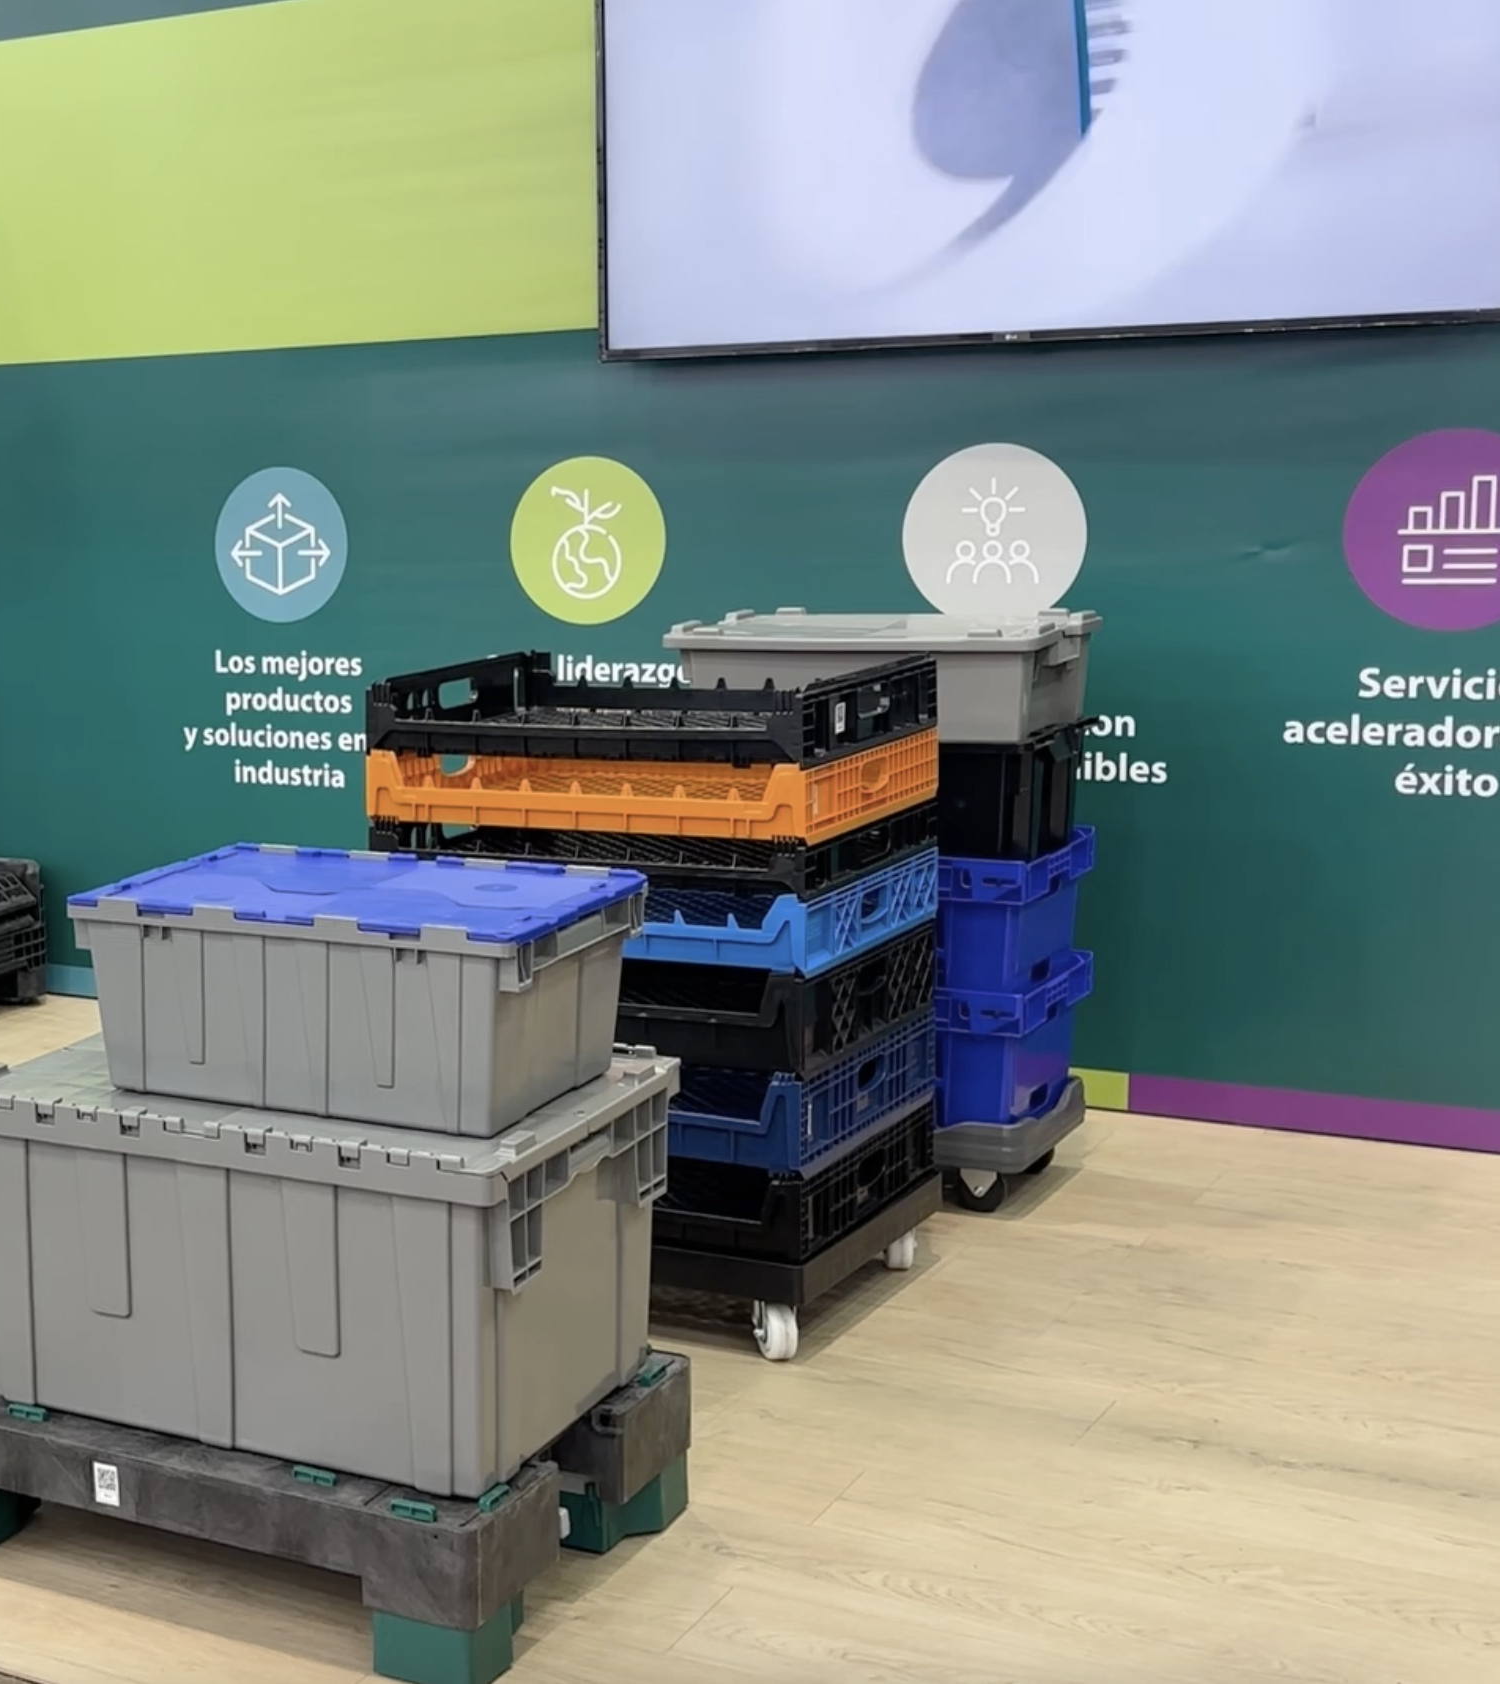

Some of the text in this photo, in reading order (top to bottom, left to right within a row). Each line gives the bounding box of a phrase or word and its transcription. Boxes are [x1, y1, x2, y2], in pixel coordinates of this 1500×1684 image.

[215, 649, 363, 682] Los mejores
[1358, 667, 1500, 701] Servici
[225, 686, 353, 716] productos
[182, 722, 367, 752] y soluciones en
[1084, 714, 1136, 738] on
[234, 758, 346, 789] industria
[1076, 751, 1168, 784] ibles
[1394, 762, 1500, 798] éxito
